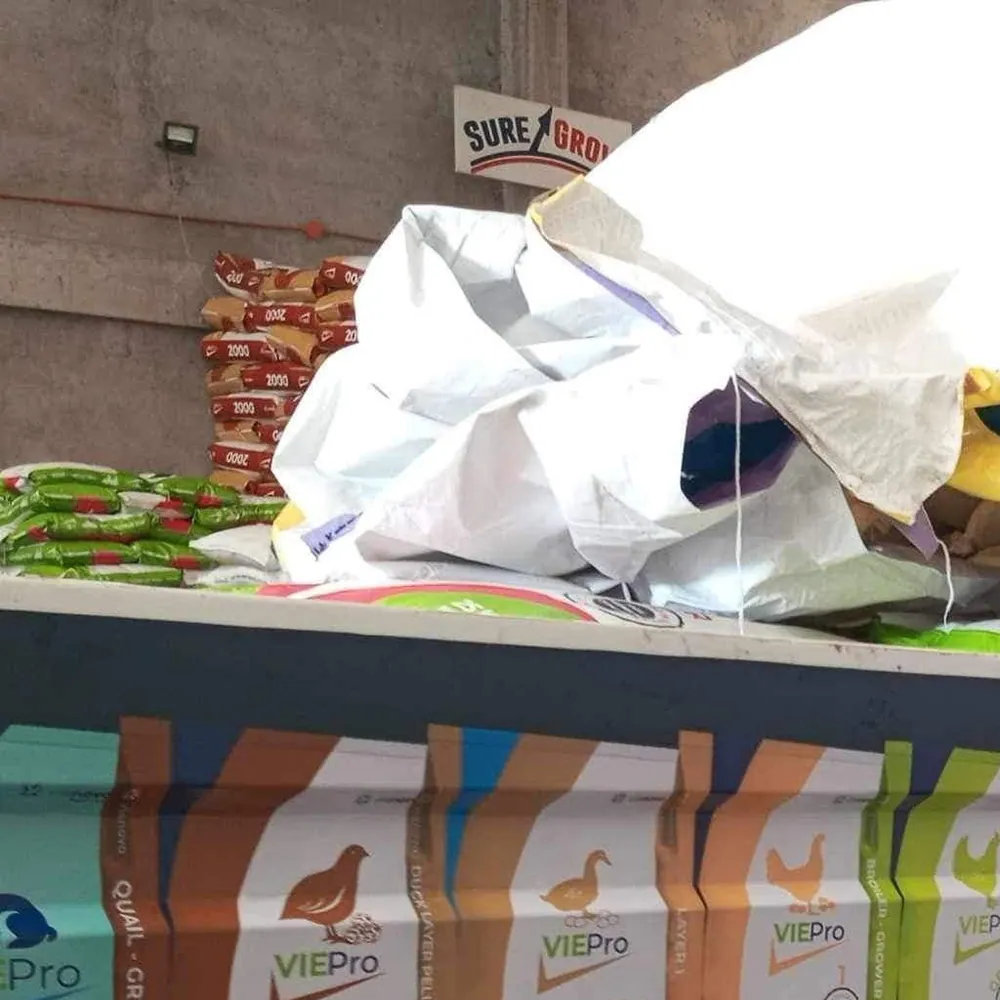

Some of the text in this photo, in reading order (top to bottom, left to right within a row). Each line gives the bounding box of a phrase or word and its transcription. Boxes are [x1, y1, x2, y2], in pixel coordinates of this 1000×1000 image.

[463, 116, 530, 152] SURE
[227, 344, 250, 357] 2000
[265, 373, 289, 388] 2000
[233, 402, 255, 415] 2000
[226, 451, 249, 466] 2000
[111, 879, 145, 948] QUAIL
[773, 921, 845, 944] VIEPro
[542, 932, 629, 959] VIEPro
[273, 950, 380, 980] VIEPro
[873, 930, 887, 999] GROWER
